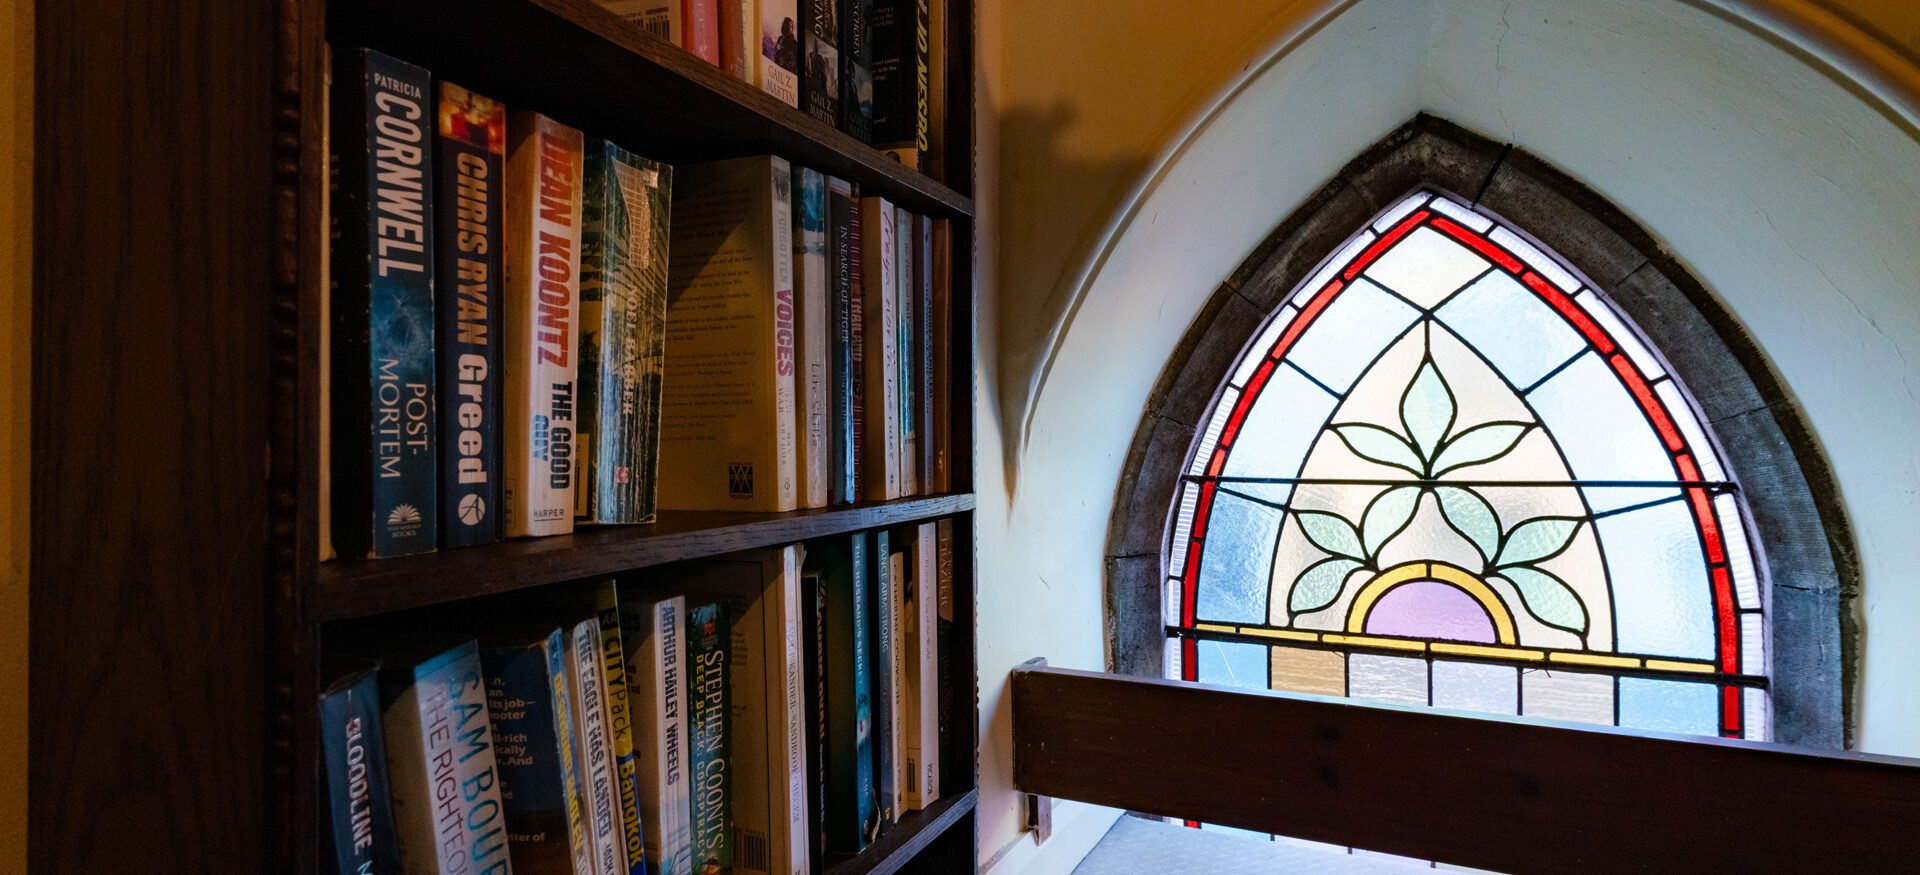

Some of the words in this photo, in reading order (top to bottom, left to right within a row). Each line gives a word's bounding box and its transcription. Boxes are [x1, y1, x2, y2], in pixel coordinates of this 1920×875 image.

[374, 72, 421, 99] PATRICIA
[766, 79, 796, 106] MARTIN
[767, 65, 784, 83] GAIL
[784, 75, 794, 88] Z.
[811, 89, 827, 109] GAIL
[918, 54, 928, 152] NESBO
[810, 103, 836, 127] MARTIN
[374, 91, 424, 277] CORNWELL
[456, 151, 488, 255] CHRIS
[540, 131, 573, 227] DEAN
[779, 210, 789, 284] FORGOTTEN
[840, 225, 847, 240] IN
[840, 242, 849, 286] SEARCH
[457, 258, 488, 345] RYAN
[538, 229, 571, 368] KOONTZ
[841, 289, 849, 306] OF
[841, 309, 849, 344] TIGER
[851, 296, 863, 362] THAILAND
[777, 289, 793, 377] VOICES
[551, 381, 573, 421] THE
[623, 338, 636, 416] BARBER
[379, 358, 401, 478] MORTEM
[405, 383, 428, 455] POST-
[458, 353, 488, 484] Greed
[532, 414, 549, 462] GUY
[550, 427, 572, 489] GOOD
[533, 508, 565, 518] HARPER
[880, 543, 889, 580] LANCE
[940, 537, 948, 607] FRAZIER
[578, 630, 593, 668] THE
[662, 606, 676, 667] ARTHUR
[881, 582, 889, 653] ARMSTRONG
[582, 668, 599, 727] EAGLE
[665, 667, 678, 719] HAILEY
[695, 655, 705, 694] DEEP
[704, 649, 724, 752] STEPHEN
[426, 686, 450, 750] THE
[449, 671, 489, 764] SAM
[489, 711, 527, 721] ooter
[588, 726, 604, 767] HAS
[507, 756, 534, 766] And
[604, 636, 632, 740] CITYPack
[618, 762, 643, 867] Bangkok
[666, 724, 679, 785] WHEELS
[345, 717, 373, 856] BLOODLINE
[432, 750, 468, 875] RIGHTEO
[593, 765, 612, 839] LANDED
[696, 760, 706, 857] CONSPIRACY
[705, 756, 726, 849] COONTS'
